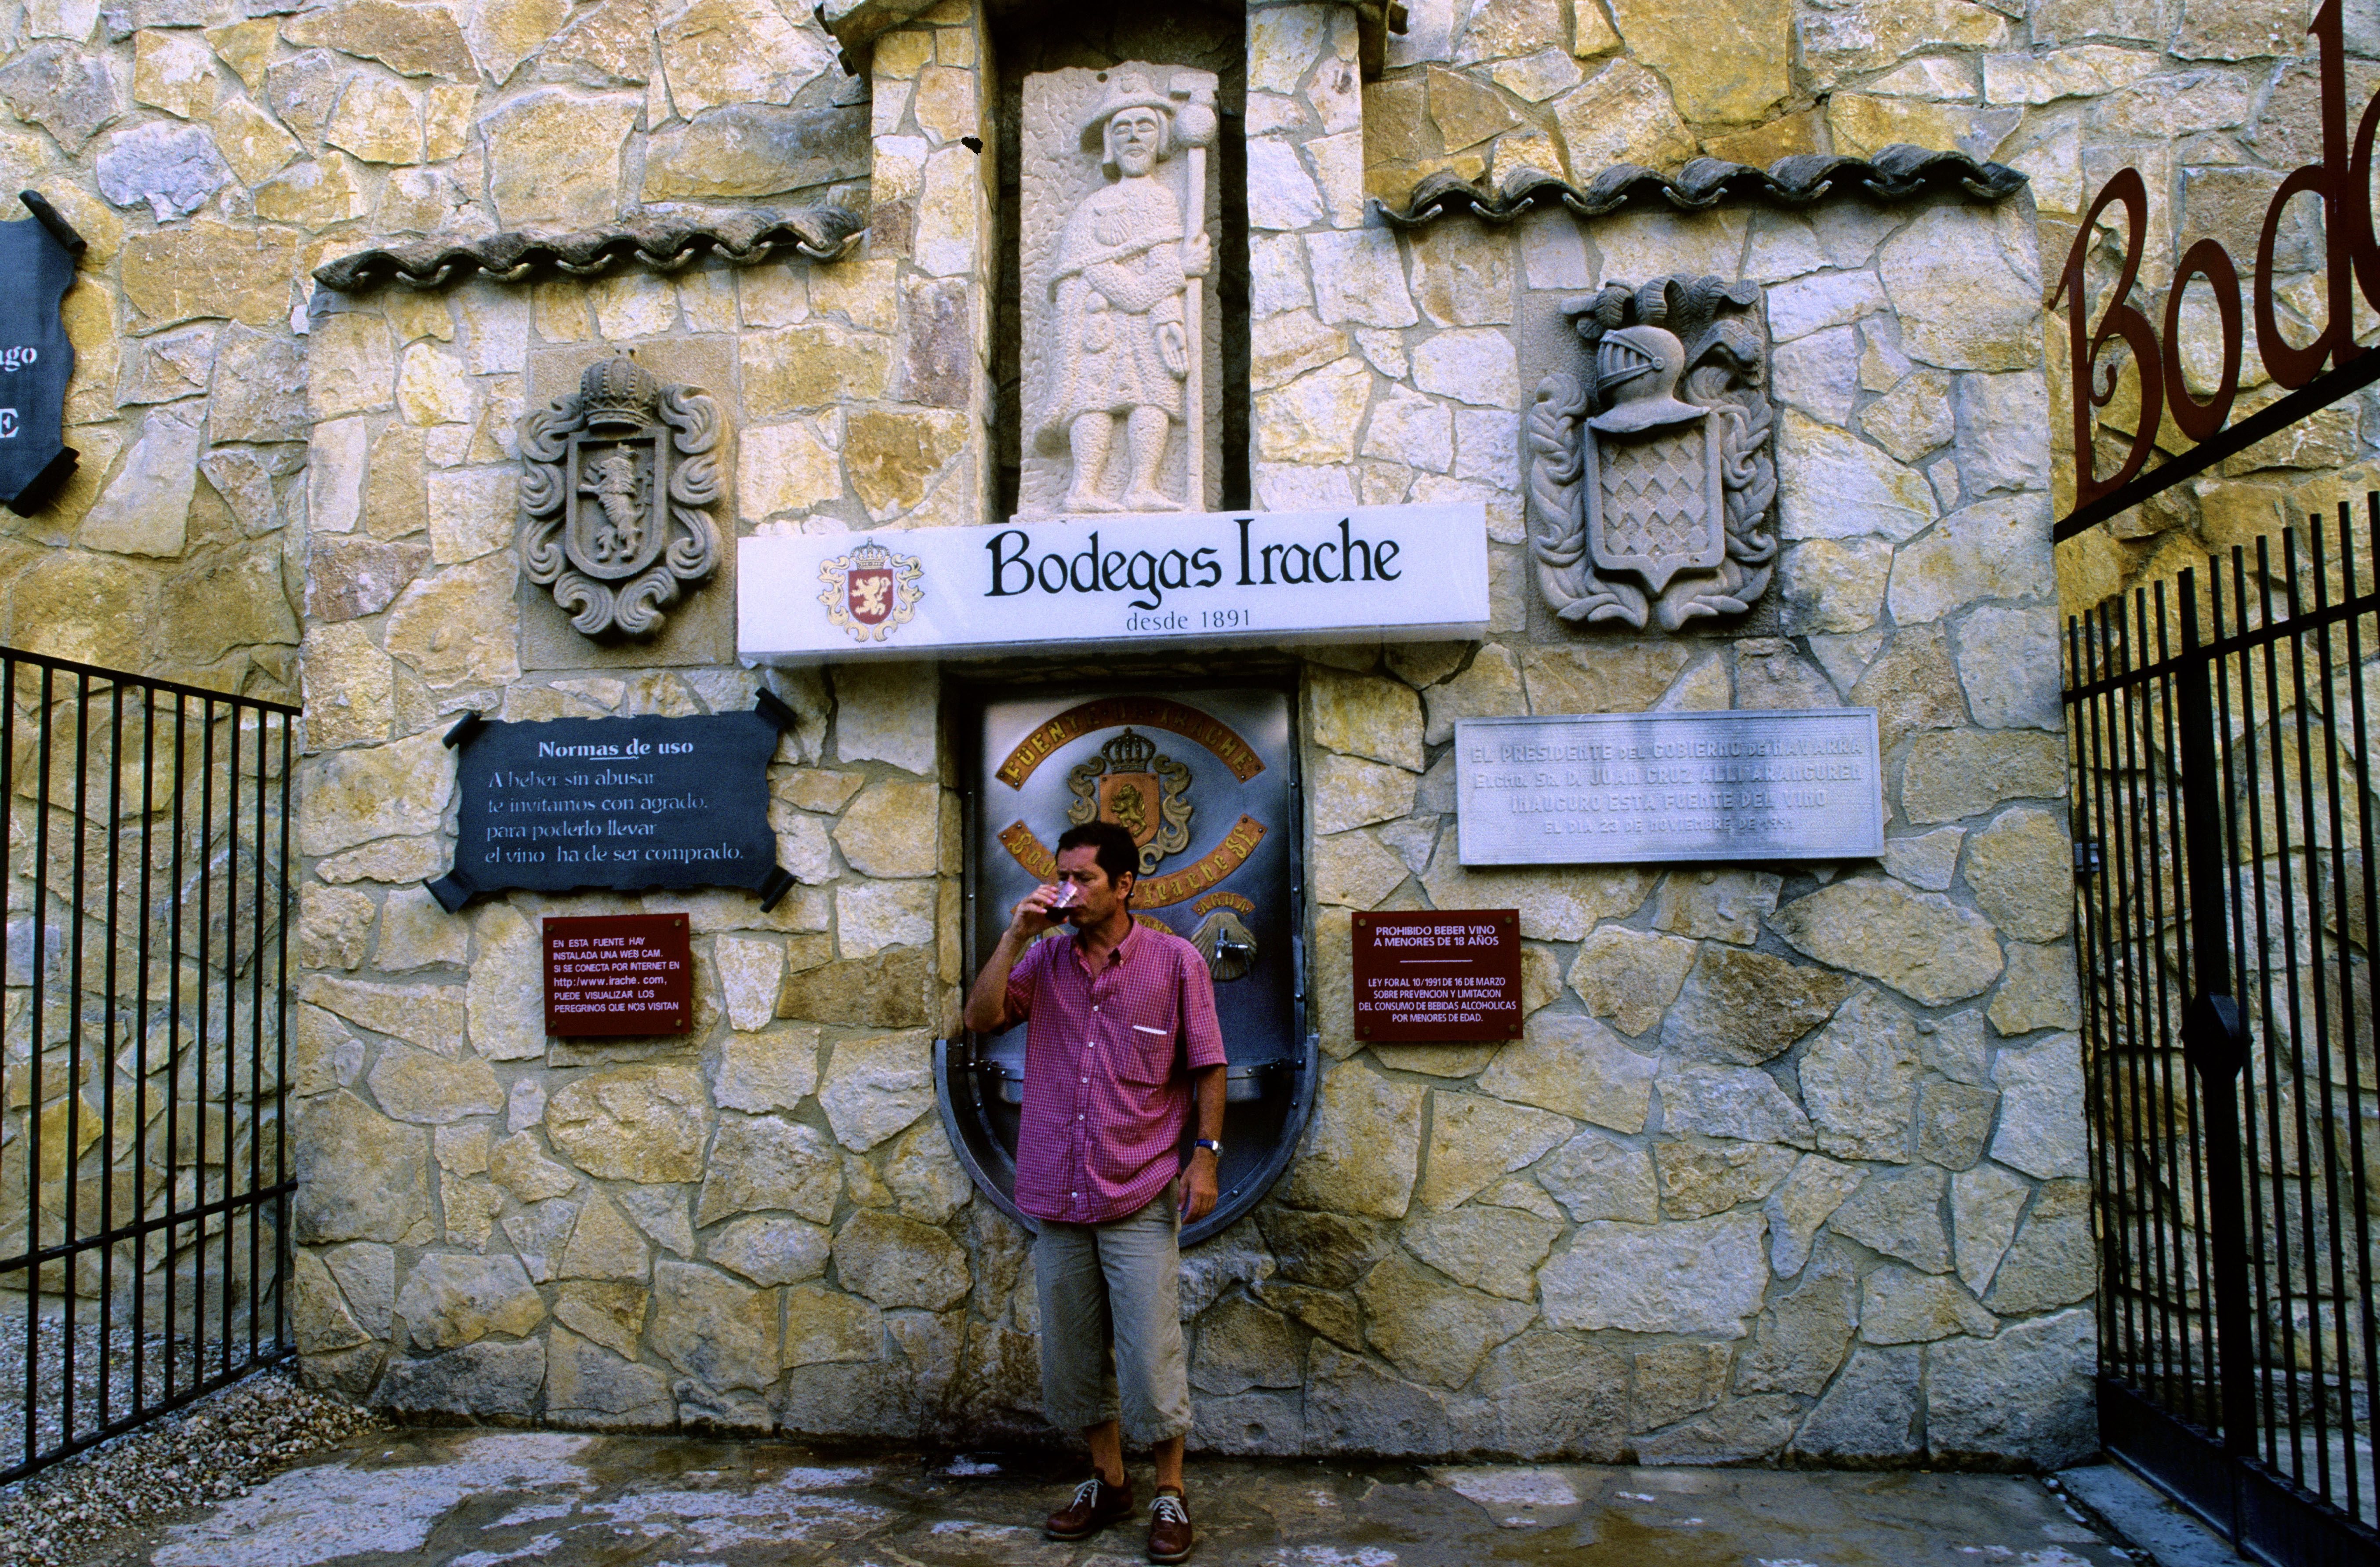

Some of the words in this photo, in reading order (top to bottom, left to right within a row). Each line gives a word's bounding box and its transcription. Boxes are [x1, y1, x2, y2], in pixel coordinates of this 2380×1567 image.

[0, 346, 37, 372] go
[984, 531, 1222, 610] Bodegas
[1234, 518, 1401, 585] Irache
[1126, 610, 1190, 632] desde
[1202, 610, 1248, 628] 1891
[539, 742, 619, 757] Normas
[626, 738, 650, 755] de
[659, 743, 693, 754] uso
[489, 772, 502, 787] A
[509, 771, 558, 787] beber
[564, 770, 589, 785] sin
[595, 769, 655, 785] abusar
[488, 797, 503, 813] te
[509, 796, 595, 812] invitamos
[602, 799, 633, 810] con
[641, 793, 707, 814] agrado.
[487, 827, 526, 841] para
[533, 820, 601, 840] poderlo
[608, 820, 658, 835] llevar
[485, 847, 499, 862] el
[507, 848, 544, 862] vino
[558, 846, 579, 862] ha
[585, 845, 607, 861] de
[613, 850, 639, 861] ser
[646, 843, 743, 864] comprado.
[1200, 894, 1246, 913] AGUA
[1376, 926, 1432, 935] PROHIBIDO
[1434, 926, 1465, 935] BEBER
[1469, 925, 1495, 935] VINO
[569, 939, 588, 947] ESTA
[594, 938, 624, 946] FUENTE
[1374, 938, 1382, 946] A
[1385, 937, 1434, 946] MENORES
[1437, 937, 1451, 945] DE
[1454, 937, 1464, 945] 18
[1468, 934, 1499, 945] AÑOS
[553, 951, 598, 960] INSTALADA
[620, 949, 639, 958] WEB
[642, 949, 663, 957] CAM.
[575, 963, 609, 972] CONECTA
[631, 962, 667, 971] INTERNET
[1368, 978, 1382, 987] LEY
[1385, 978, 1410, 987] FORAL
[1413, 978, 1440, 986] 10/1991
[1455, 978, 1462, 986] 16
[1464, 978, 1474, 986] DE
[585, 990, 633, 1000] VISUALIZAR
[1374, 990, 1398, 999] SOBRE
[1400, 990, 1448, 998] PREVENCION
[1458, 989, 1501, 998] LIMITACION
[555, 1004, 606, 1013] PEREGRINOS
[628, 1003, 645, 1011] NOS
[648, 1002, 678, 1011] VISITAN
[1360, 1002, 1372, 1011] DEL
[1375, 1002, 1414, 1011] CONSUMO
[1428, 1002, 1458, 1010] BEBIDAS
[1461, 1001, 1516, 1010] ALCOHOLICAS
[1393, 1014, 1408, 1022] POR
[1410, 1014, 1447, 1022] MENORES
